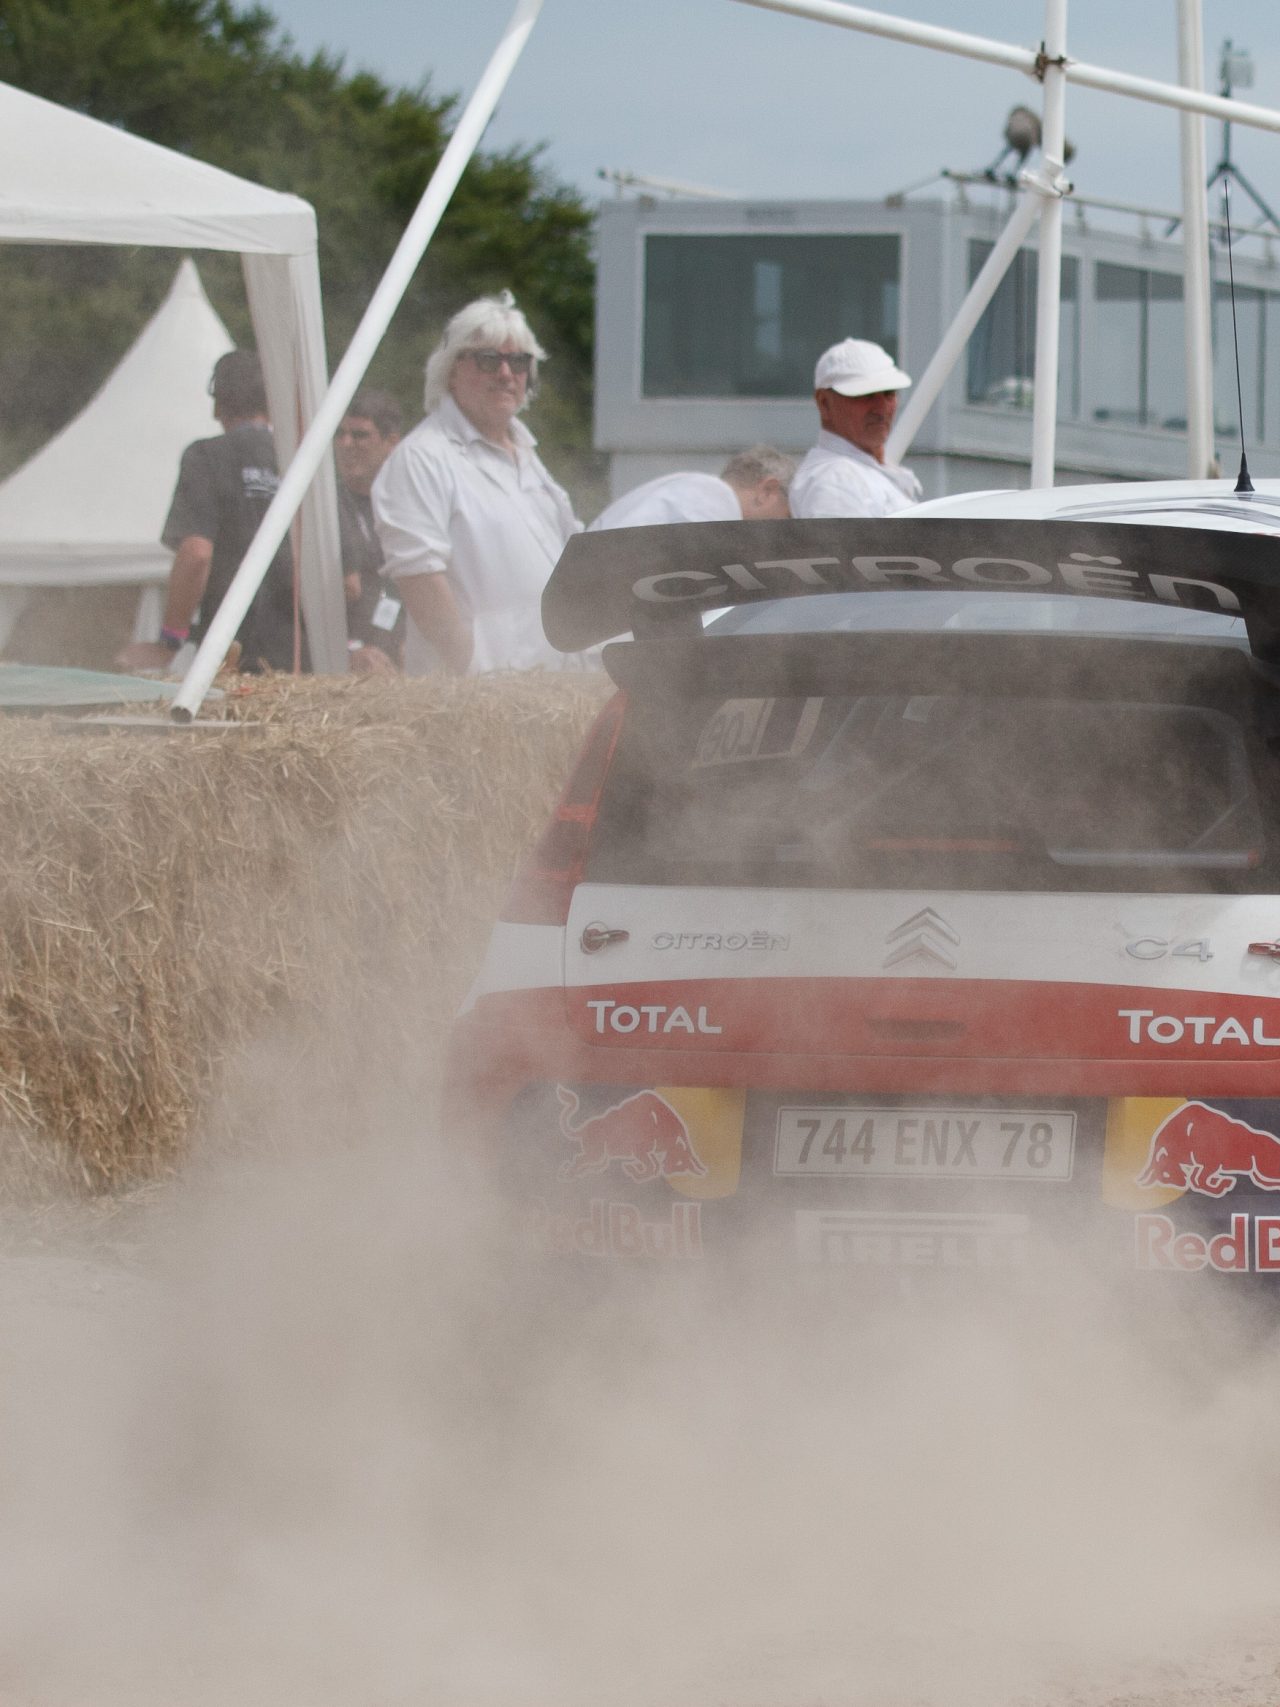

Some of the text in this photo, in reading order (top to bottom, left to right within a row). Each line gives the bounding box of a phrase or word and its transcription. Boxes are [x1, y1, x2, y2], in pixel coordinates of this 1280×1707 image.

[1126, 936, 1213, 962] C4
[796, 1118, 1054, 1169] 744 ENX 78
[609, 1202, 703, 1260] Bull
[1136, 1213, 1249, 1272] Red
